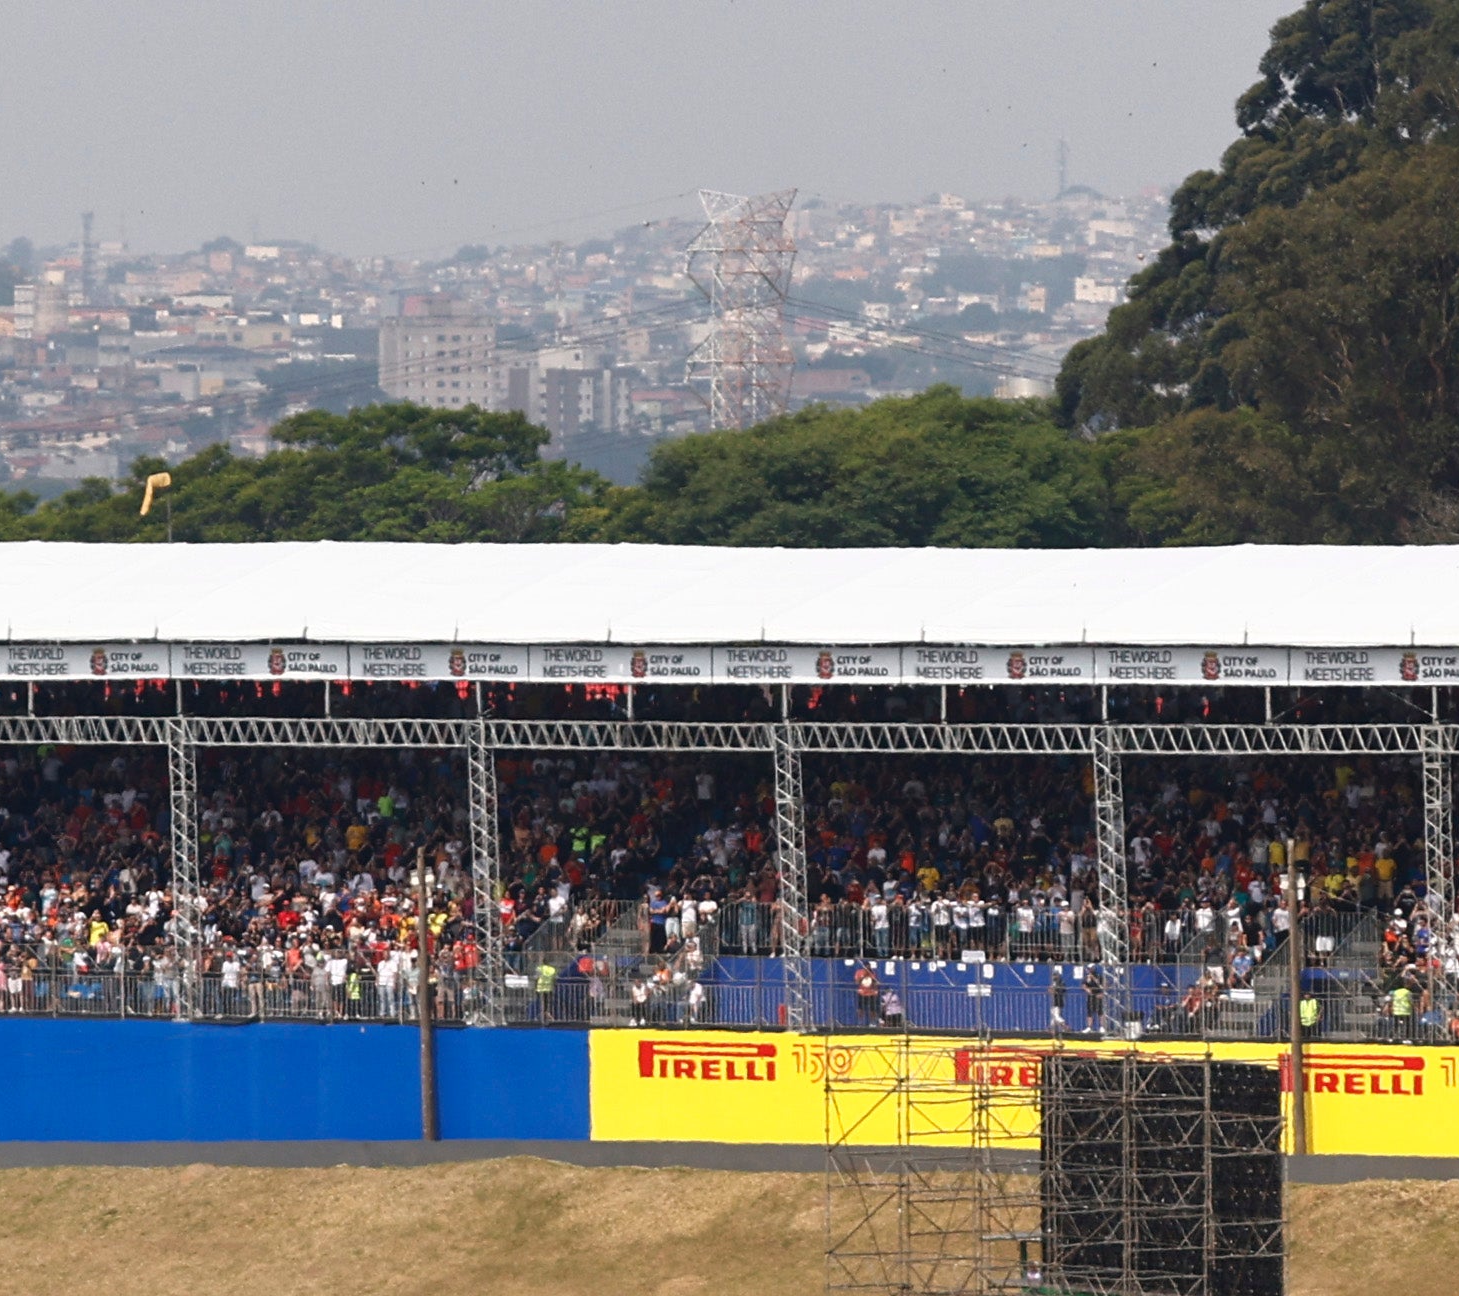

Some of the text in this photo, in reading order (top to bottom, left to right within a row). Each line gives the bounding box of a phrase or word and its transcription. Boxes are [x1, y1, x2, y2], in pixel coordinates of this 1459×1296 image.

[1306, 652, 1368, 664] THE WORLD
[1422, 657, 1457, 665] CITY OF
[1306, 668, 1374, 680] MEETS HERE
[640, 1042, 776, 1081] PIRELLI
